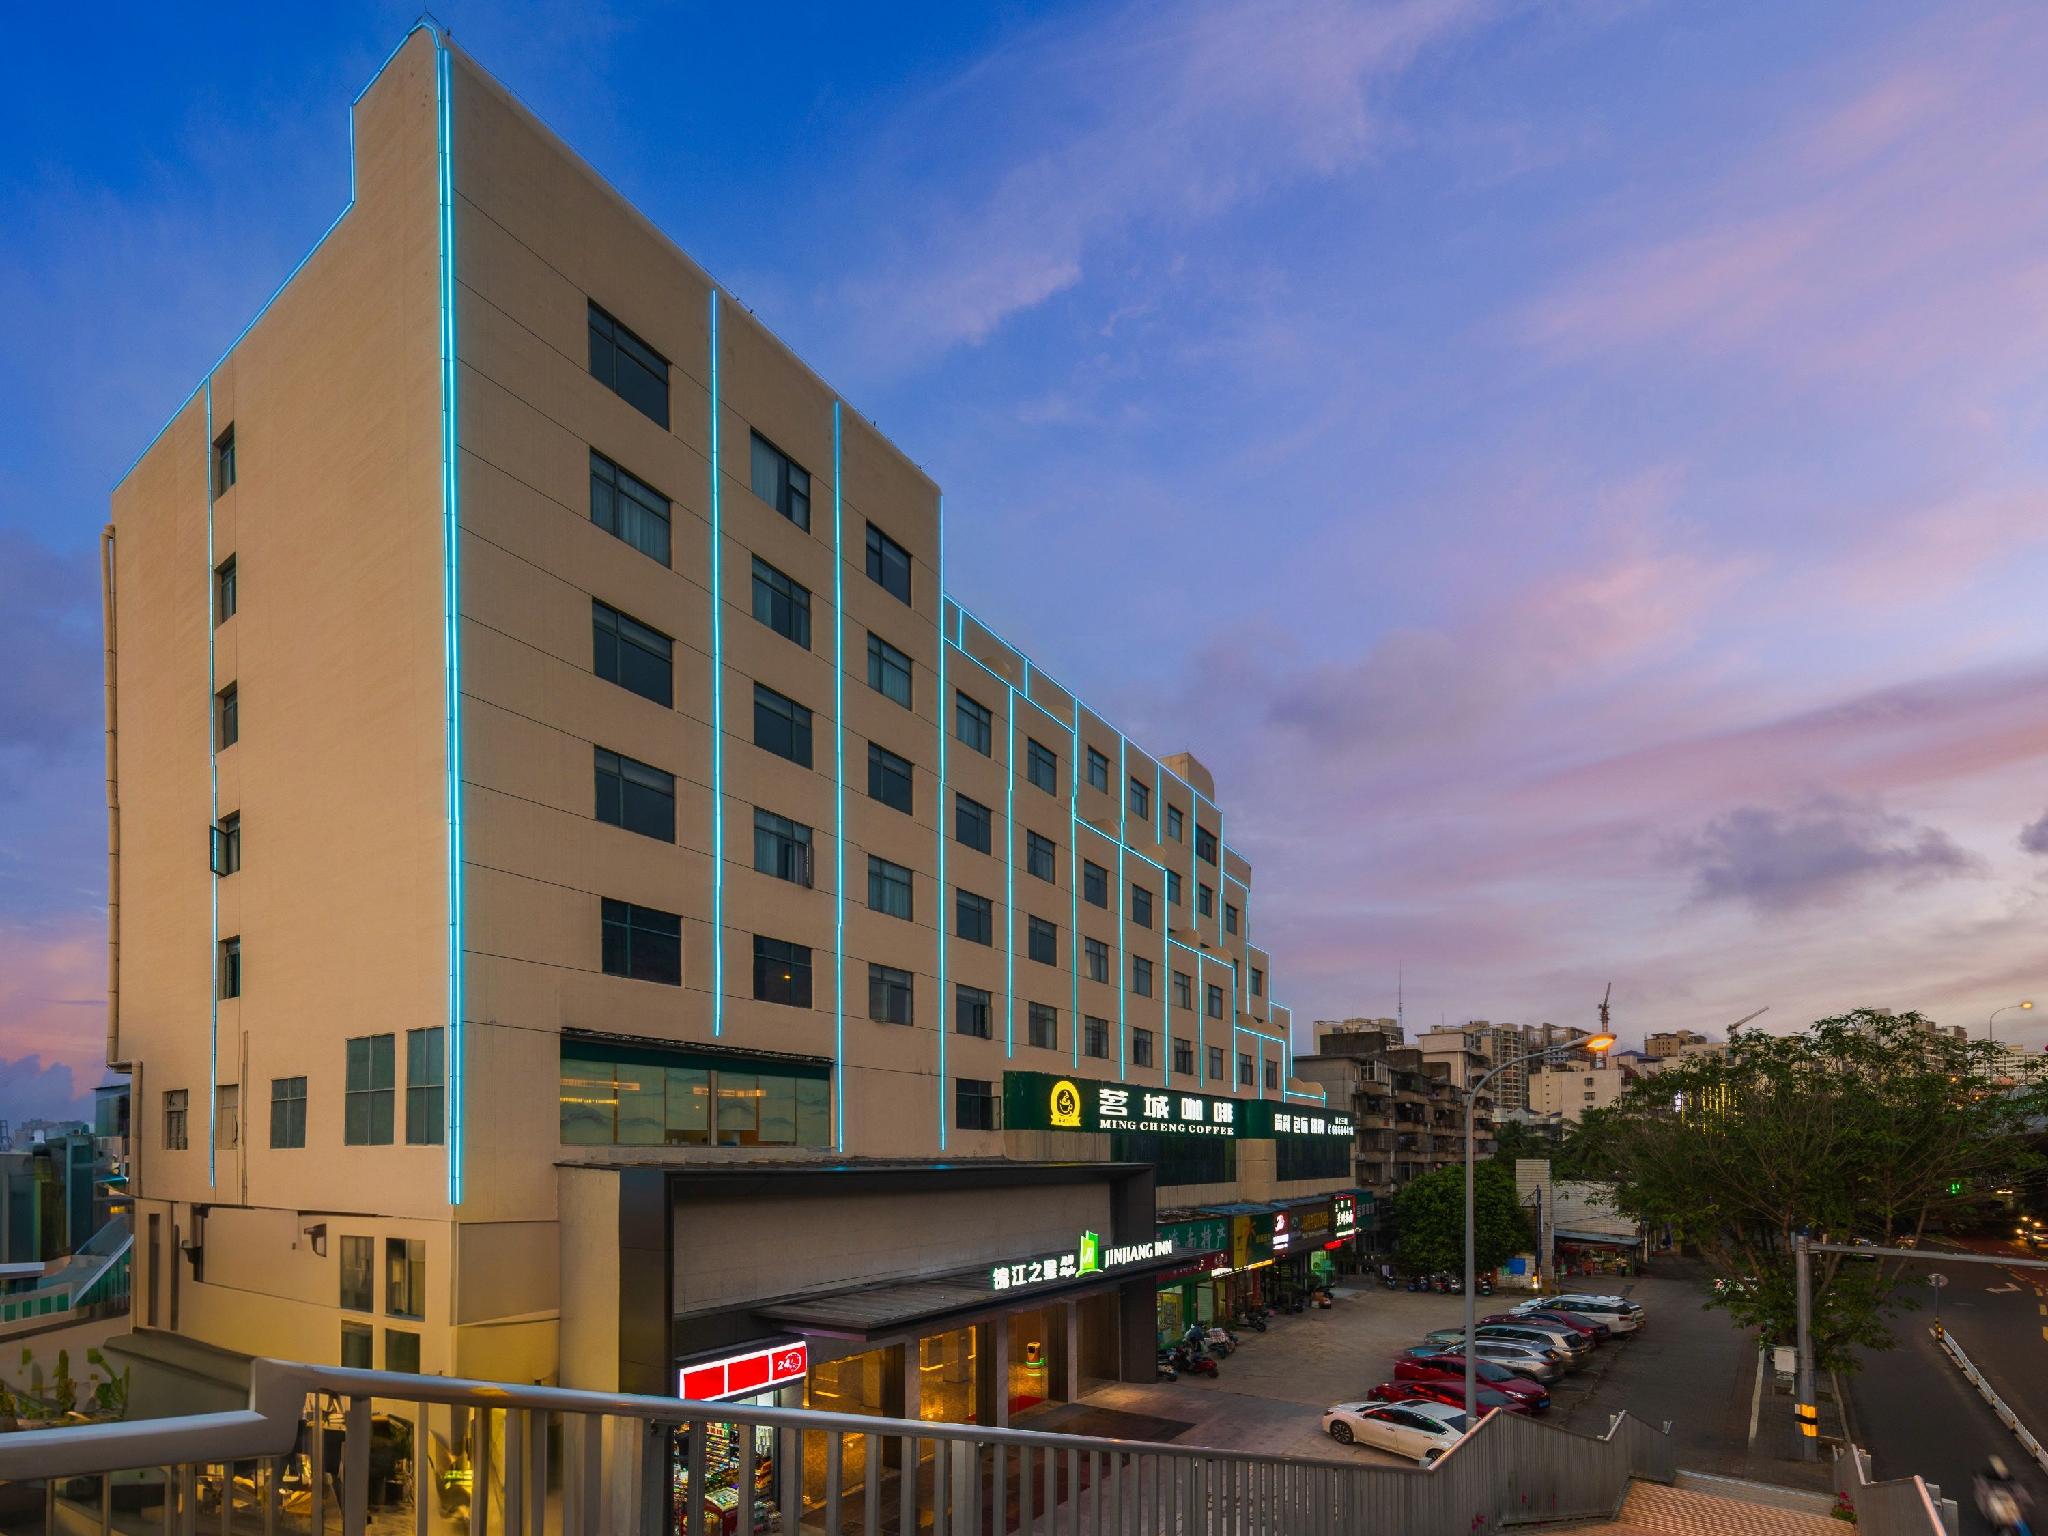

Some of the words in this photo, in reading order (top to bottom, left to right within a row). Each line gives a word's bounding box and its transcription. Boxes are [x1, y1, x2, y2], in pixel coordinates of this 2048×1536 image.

[1099, 1088, 1234, 1122] 茗城咖啡
[1100, 1119, 1137, 1130] MING
[1140, 1121, 1186, 1133] CHENG
[1188, 1125, 1234, 1136] COFFEE
[1104, 1242, 1153, 1269] JINJIANG
[1154, 1240, 1173, 1257] INN
[993, 1259, 1058, 1290] 锦江之星
